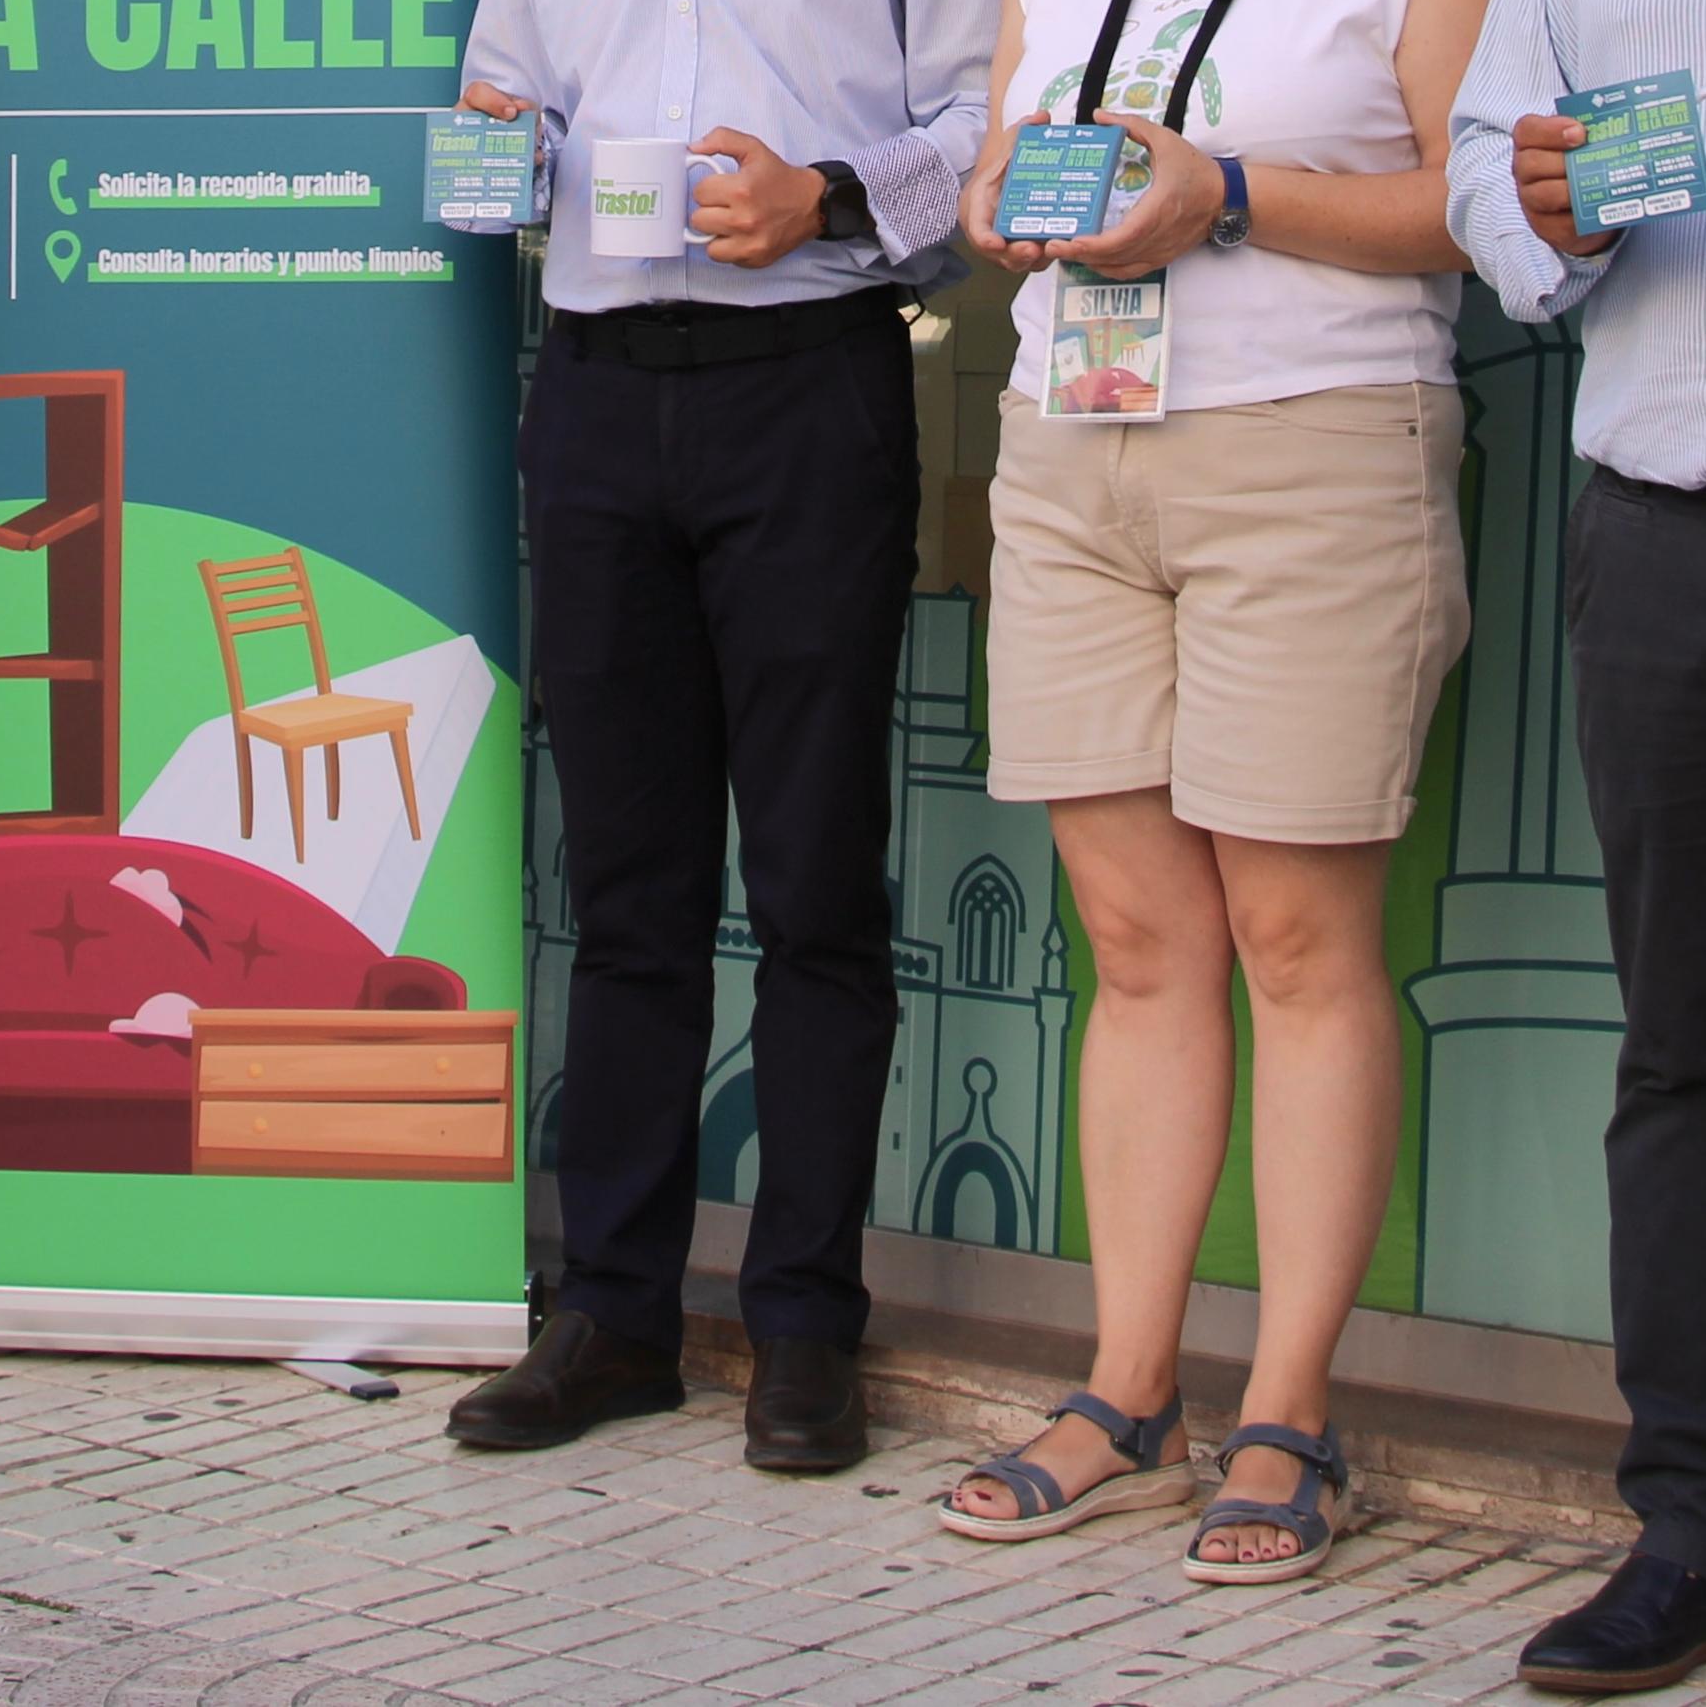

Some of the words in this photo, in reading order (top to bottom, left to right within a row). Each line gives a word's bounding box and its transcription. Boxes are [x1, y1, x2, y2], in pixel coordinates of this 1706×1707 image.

[97, 171, 173, 199] Solicita
[176, 172, 197, 198] la
[200, 171, 289, 201] recogida
[292, 170, 371, 200] gratuita
[97, 248, 186, 275] Consulta
[188, 247, 274, 274] horarios
[277, 251, 290, 277] y
[294, 248, 365, 277] puntos
[367, 246, 444, 277] limpios
[1080, 287, 1141, 317] SILVIA
